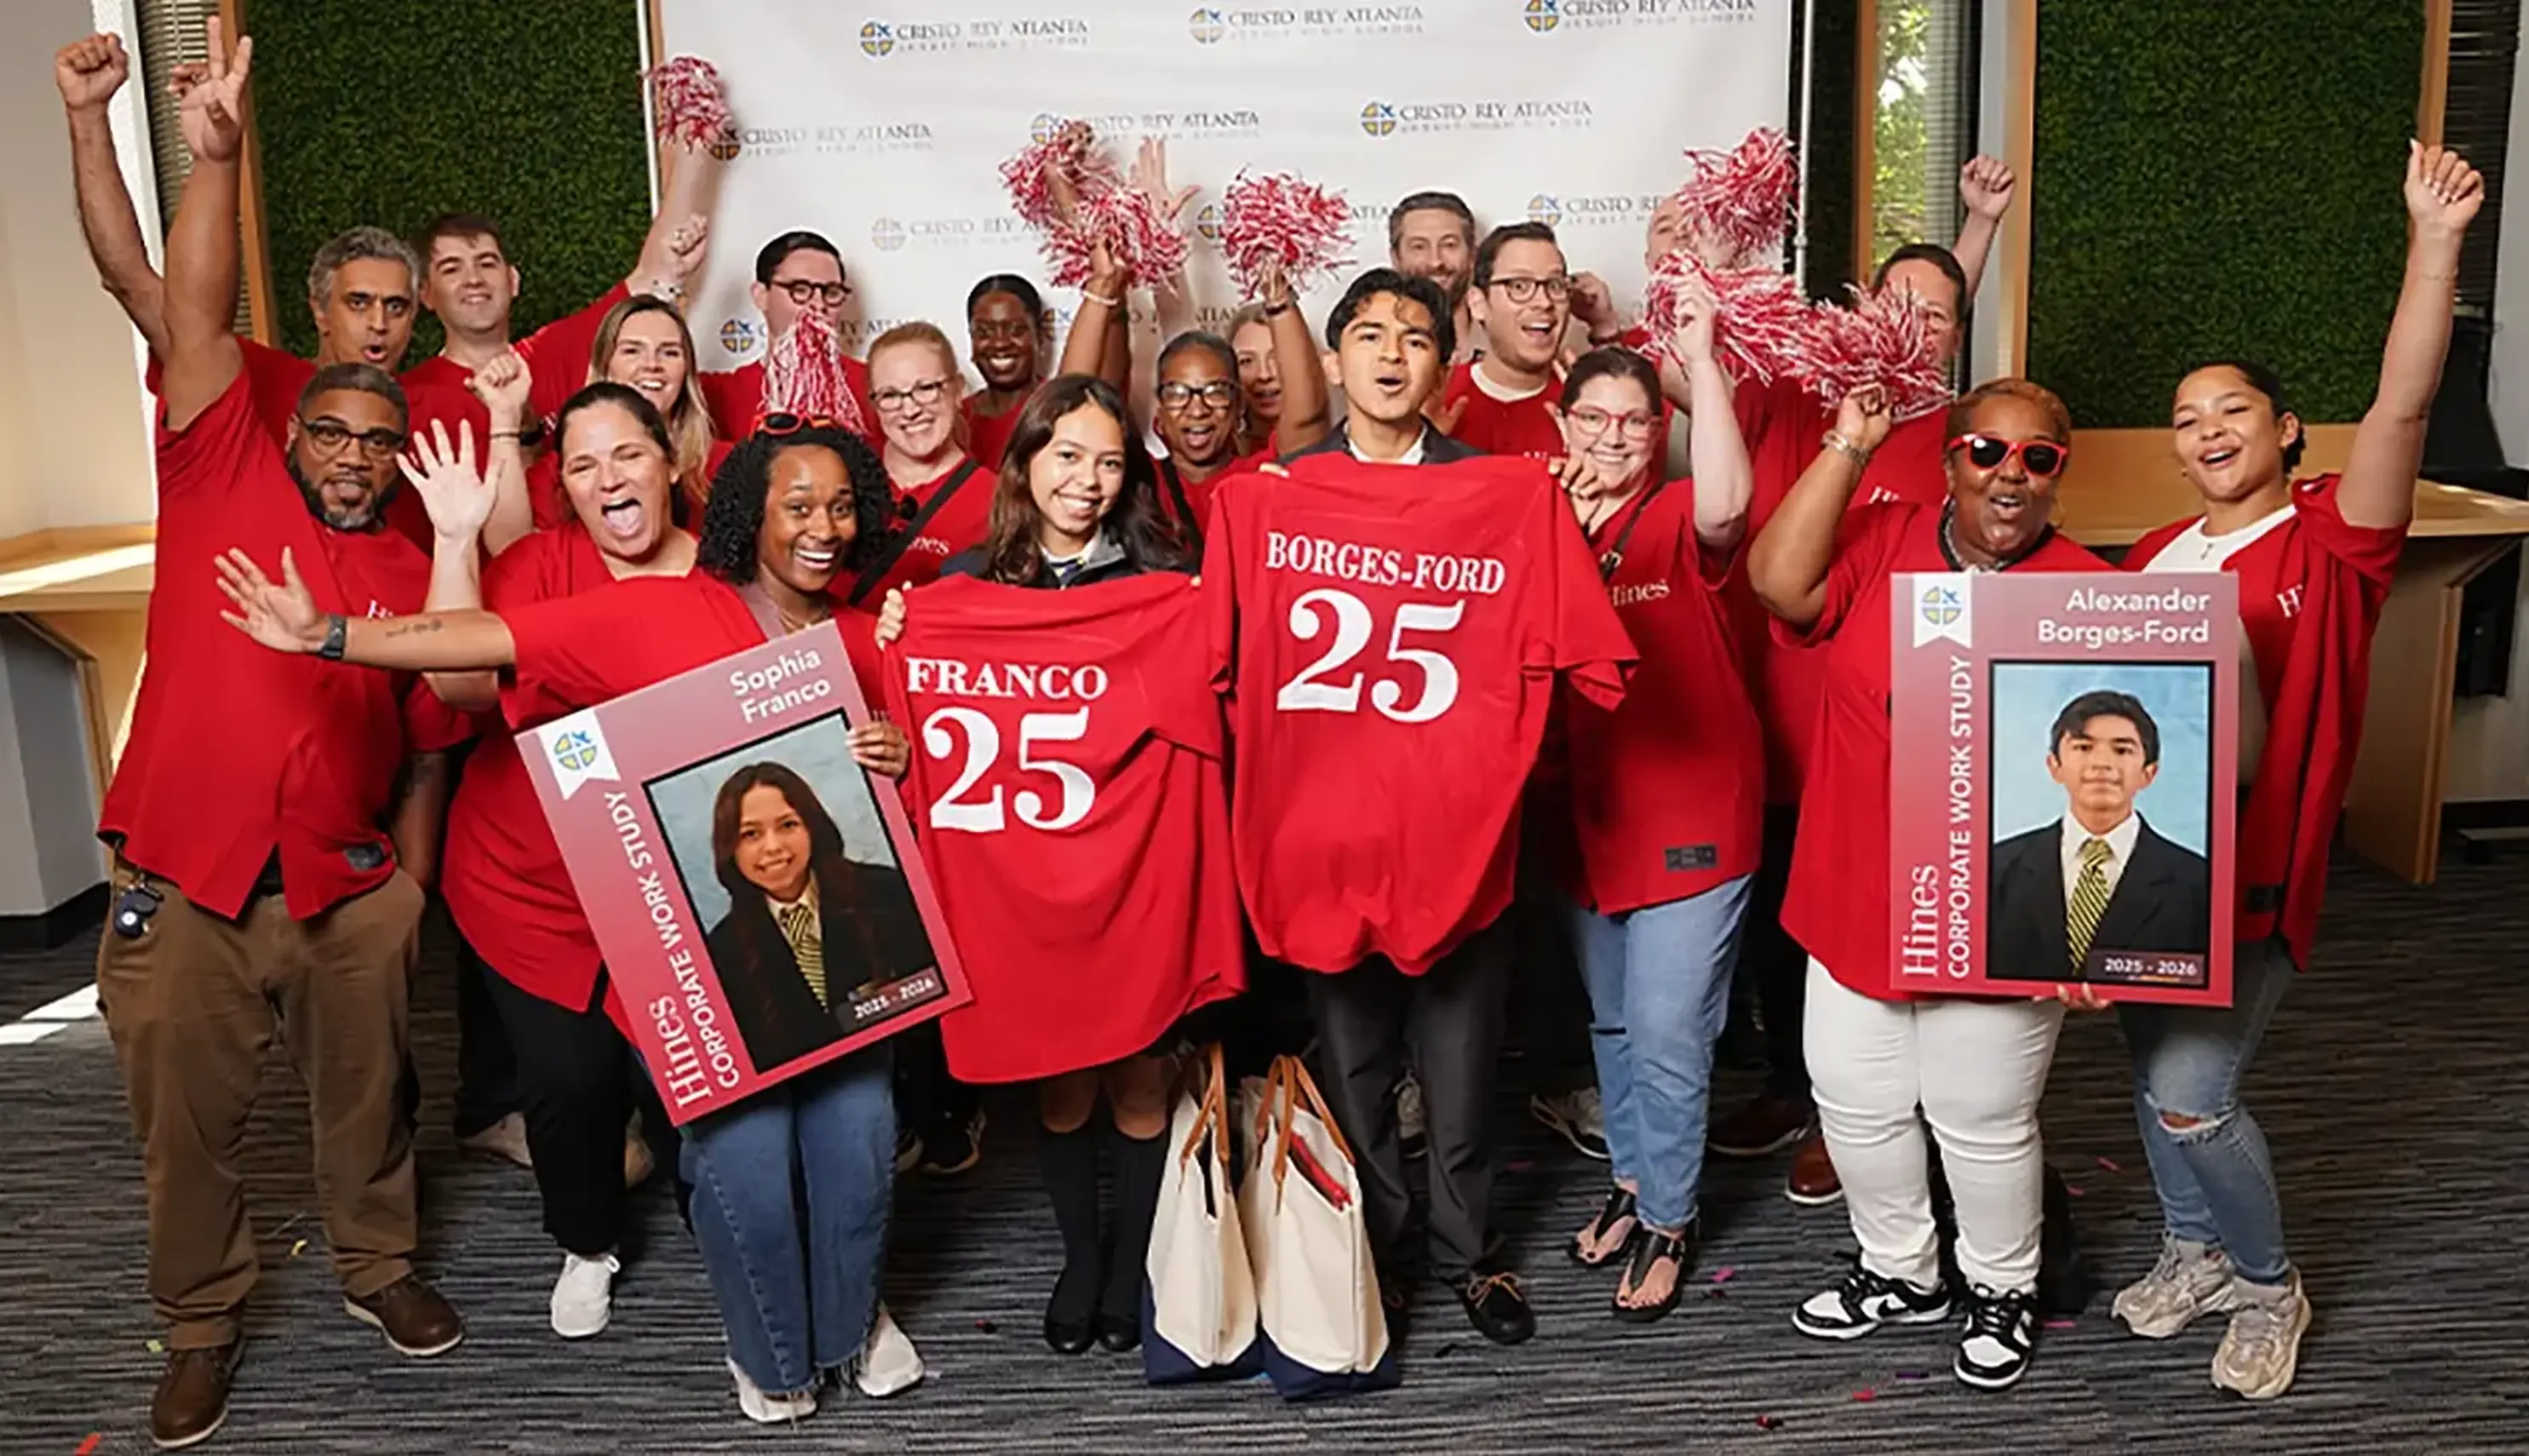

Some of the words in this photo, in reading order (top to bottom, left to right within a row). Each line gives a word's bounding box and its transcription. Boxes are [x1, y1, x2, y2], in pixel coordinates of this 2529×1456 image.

[897, 24, 961, 40] CRISTO
[1011, 19, 1088, 36] ATLANTA
[1229, 9, 1295, 26] CRISTO
[1304, 9, 1338, 24] REY
[1344, 7, 1423, 23] ATLANTA
[856, 124, 932, 140] ATLANTA
[1182, 112, 1259, 127] ATLANTA
[1400, 104, 1466, 120] CRISTO
[1475, 103, 1507, 118] REY
[1514, 101, 1593, 118] ATLANTA
[1566, 197, 1632, 213] CRISTO
[1265, 531, 1505, 593] BORGES-FORD
[2066, 587, 2211, 611] Alexander
[1276, 588, 1465, 723] 25
[2038, 618, 2209, 649] Borges-Ford
[730, 650, 822, 696] Sophia
[905, 656, 1108, 699] FRANCO
[1950, 655, 1973, 737] STUDY
[741, 679, 831, 723] Franco
[922, 705, 1095, 833] 25
[1949, 745, 1972, 823] WORK
[604, 792, 653, 869] STUDY
[638, 869, 683, 949] WORK
[1902, 864, 1939, 977] Hines
[1948, 830, 1971, 978] CORPORATE
[2104, 957, 2143, 972] 2025
[2157, 960, 2197, 976] 2026
[668, 949, 739, 1087] CORPORATE
[649, 995, 713, 1109] Hines
